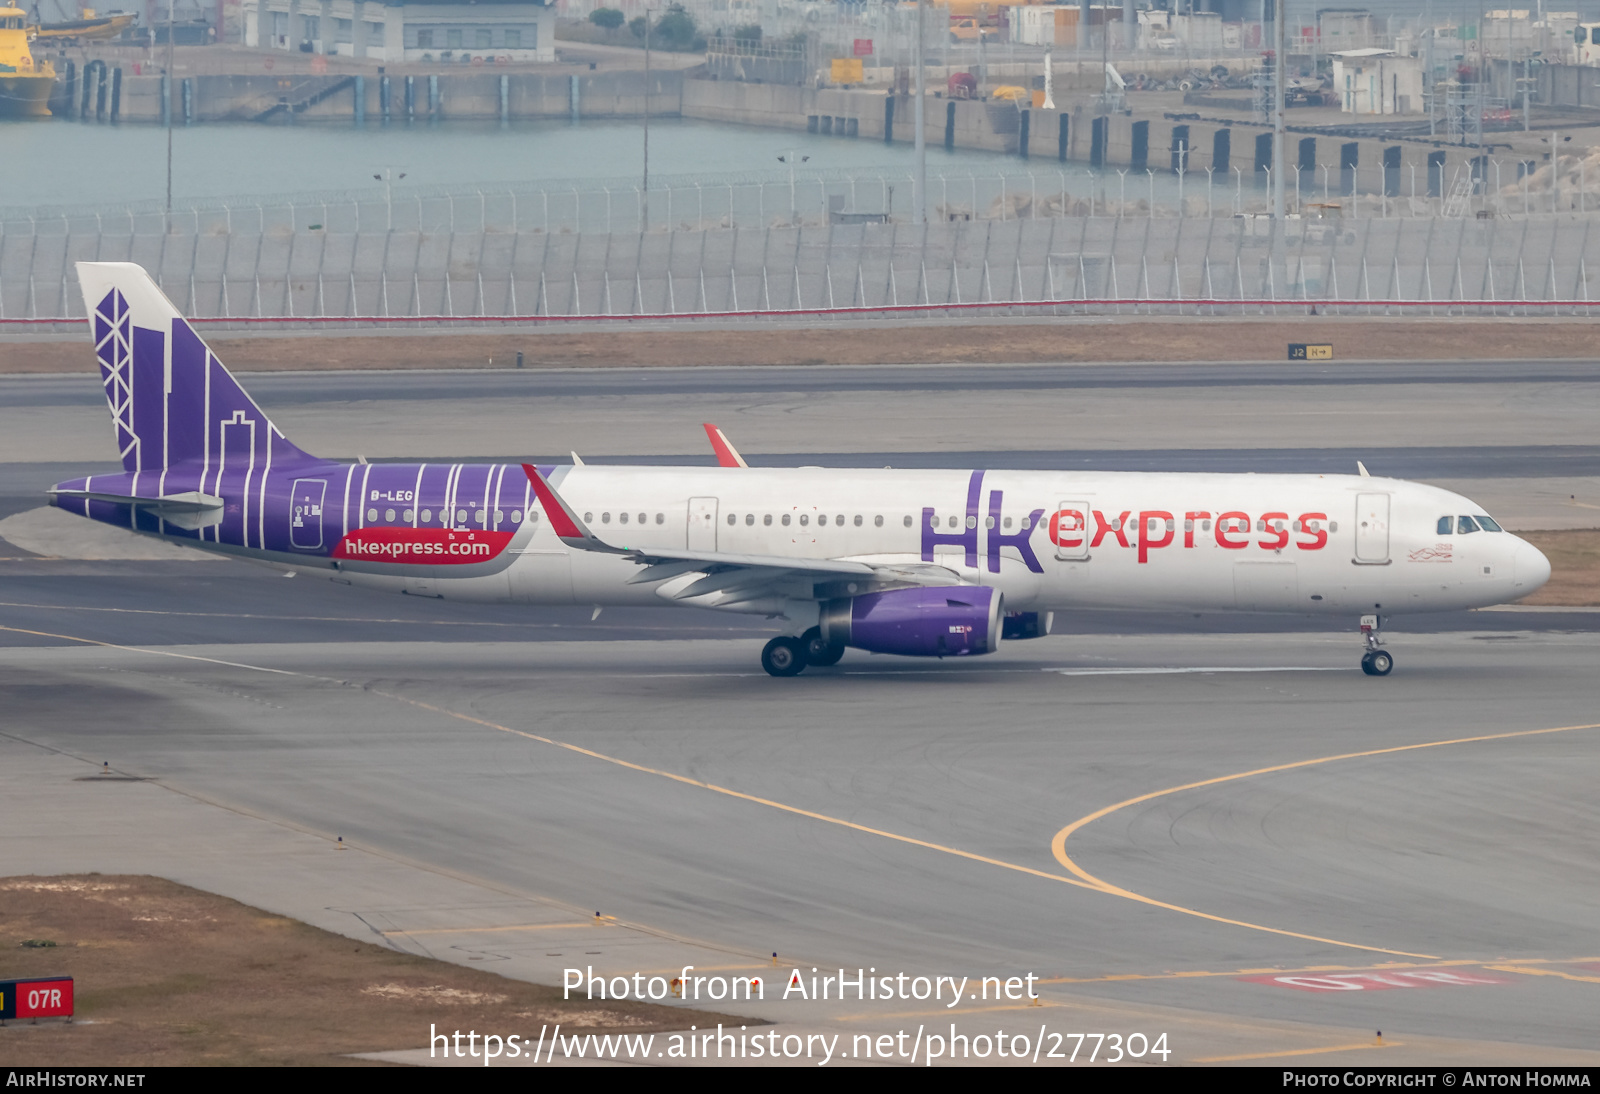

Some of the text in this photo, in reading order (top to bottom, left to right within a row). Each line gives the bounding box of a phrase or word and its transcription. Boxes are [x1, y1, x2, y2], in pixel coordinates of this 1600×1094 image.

[1292, 348, 1317, 357] J2 H
[371, 490, 413, 501] B-LEG
[345, 539, 490, 558] hkexpress.com
[28, 989, 62, 1009] 07R
